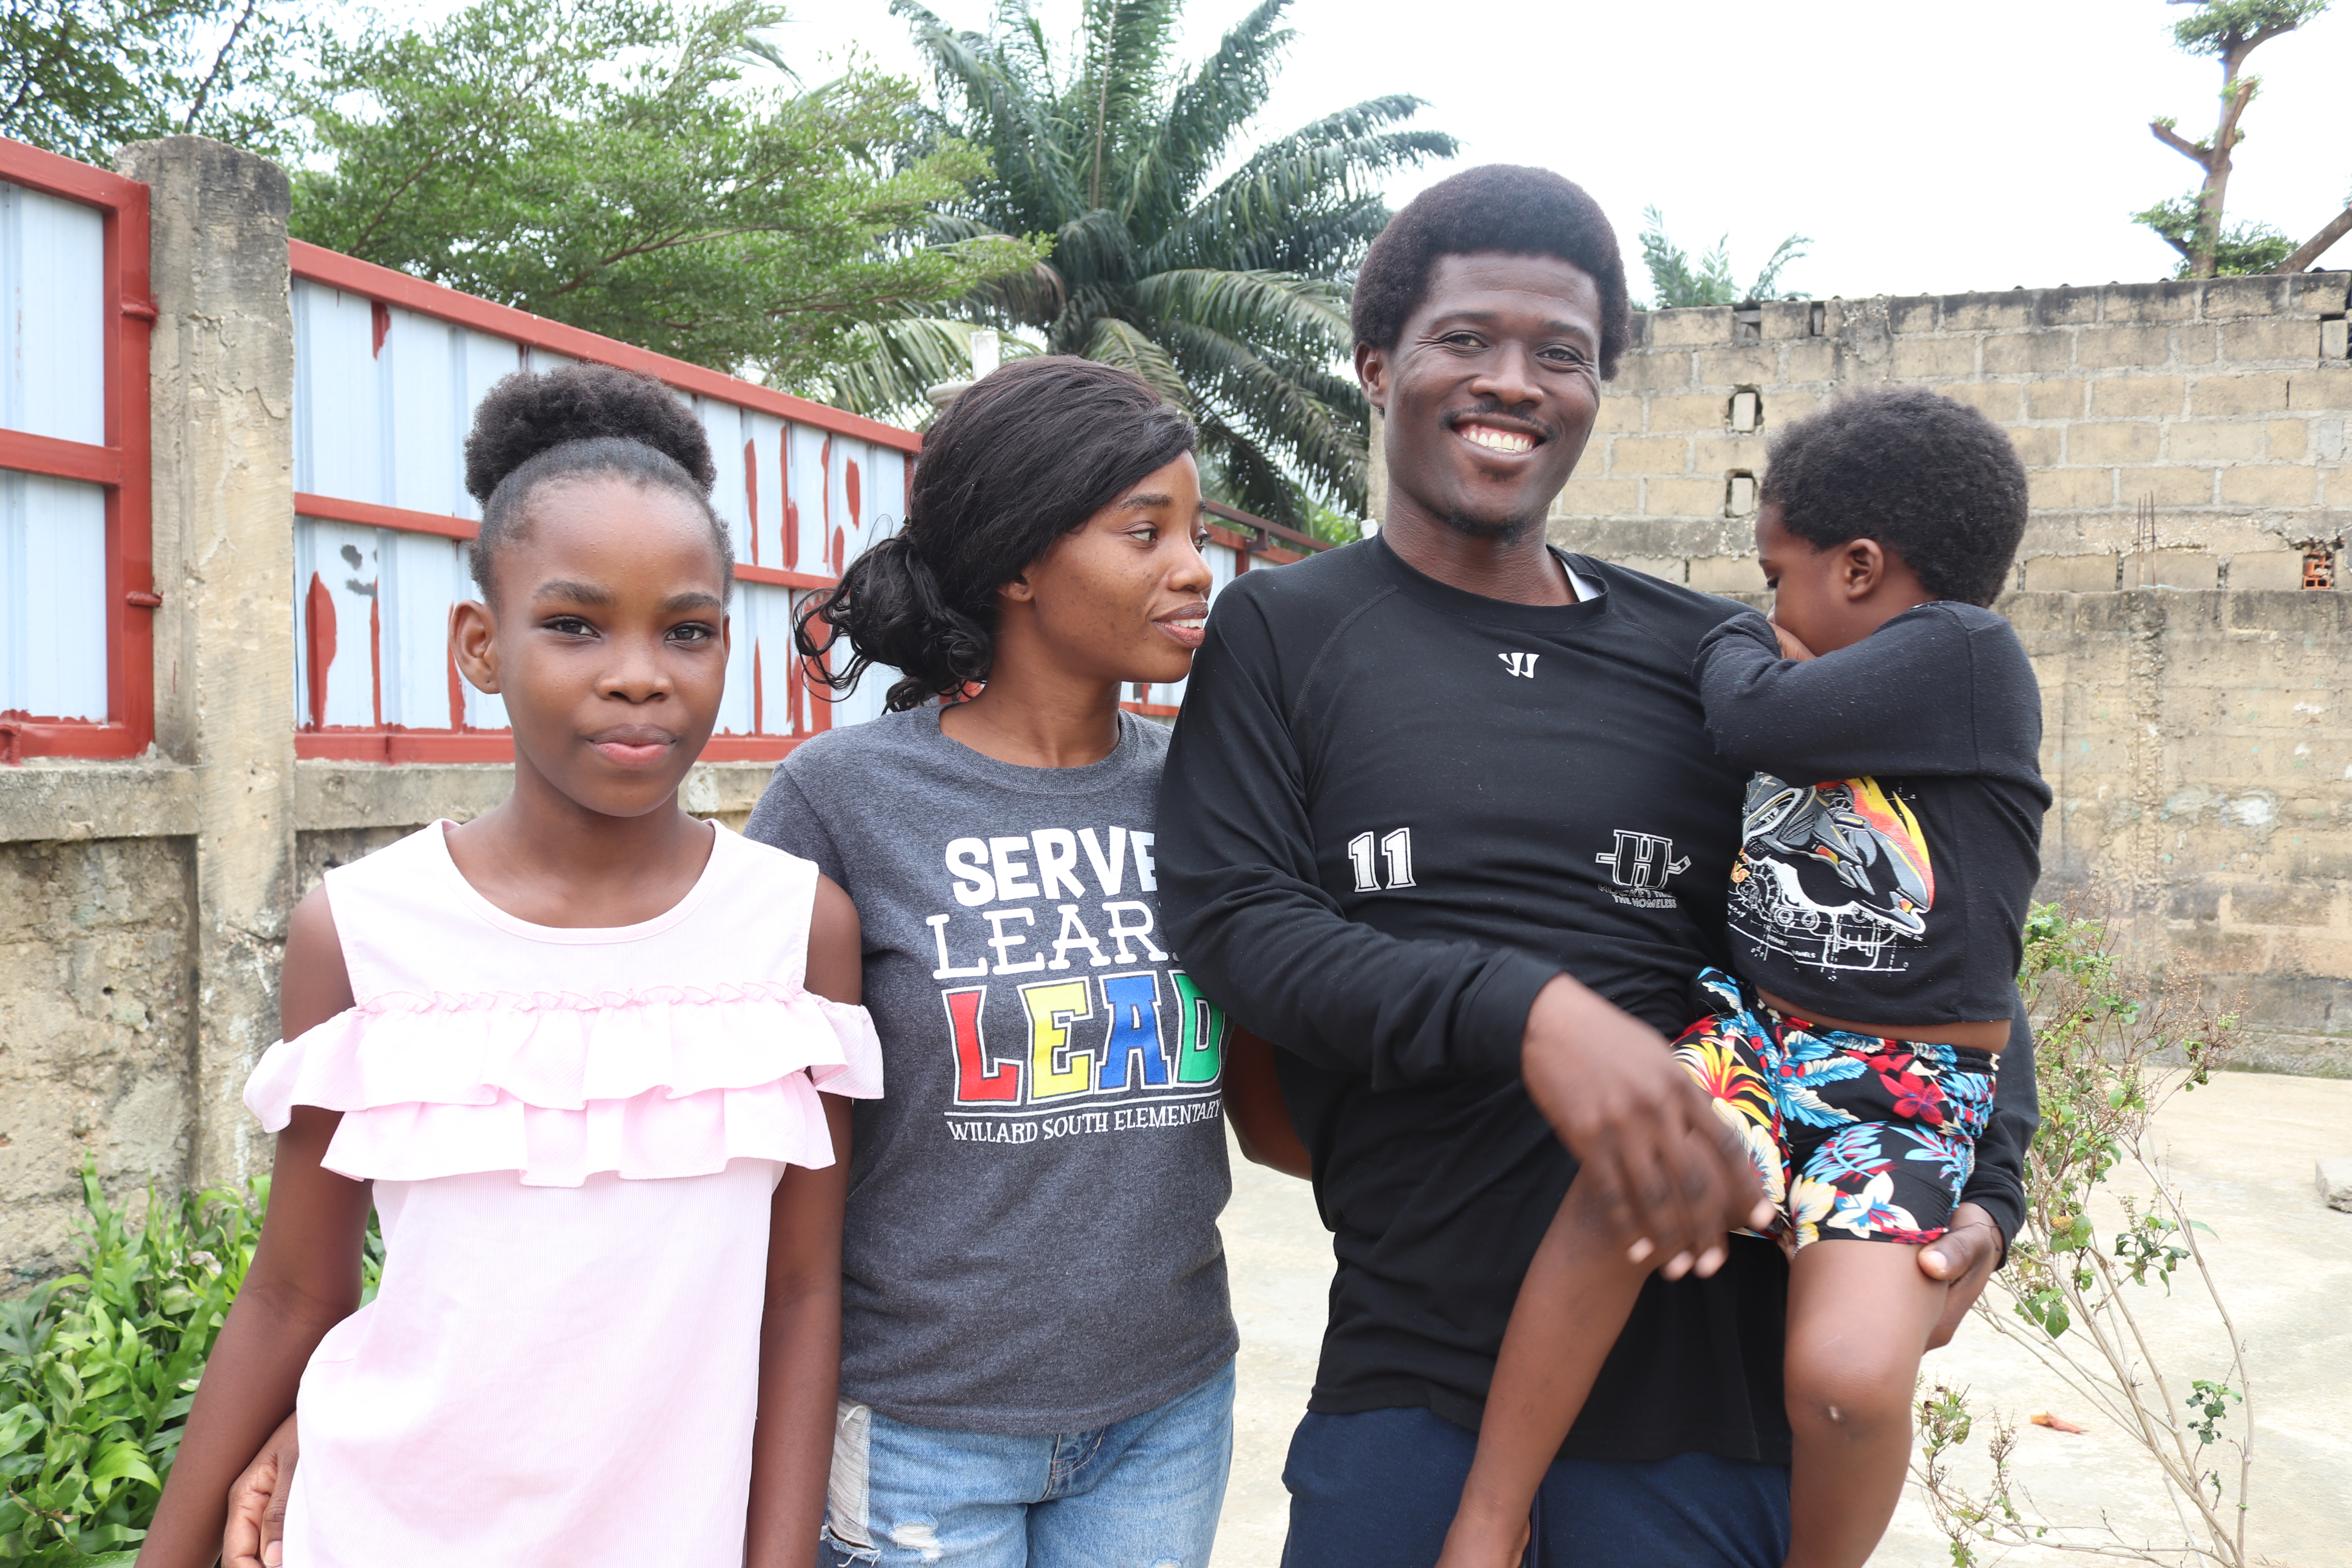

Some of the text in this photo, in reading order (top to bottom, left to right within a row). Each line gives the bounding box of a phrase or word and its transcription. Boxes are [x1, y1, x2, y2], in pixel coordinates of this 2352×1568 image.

[945, 826, 1158, 906] SERVE
[1348, 827, 1417, 893] 11
[1612, 895, 1677, 908] THE HOMELESS
[926, 900, 1179, 979] LEAR
[941, 970, 1225, 1106] LEAD
[947, 1098, 1223, 1144] WILLARD SOUTH ELEMENTARY
